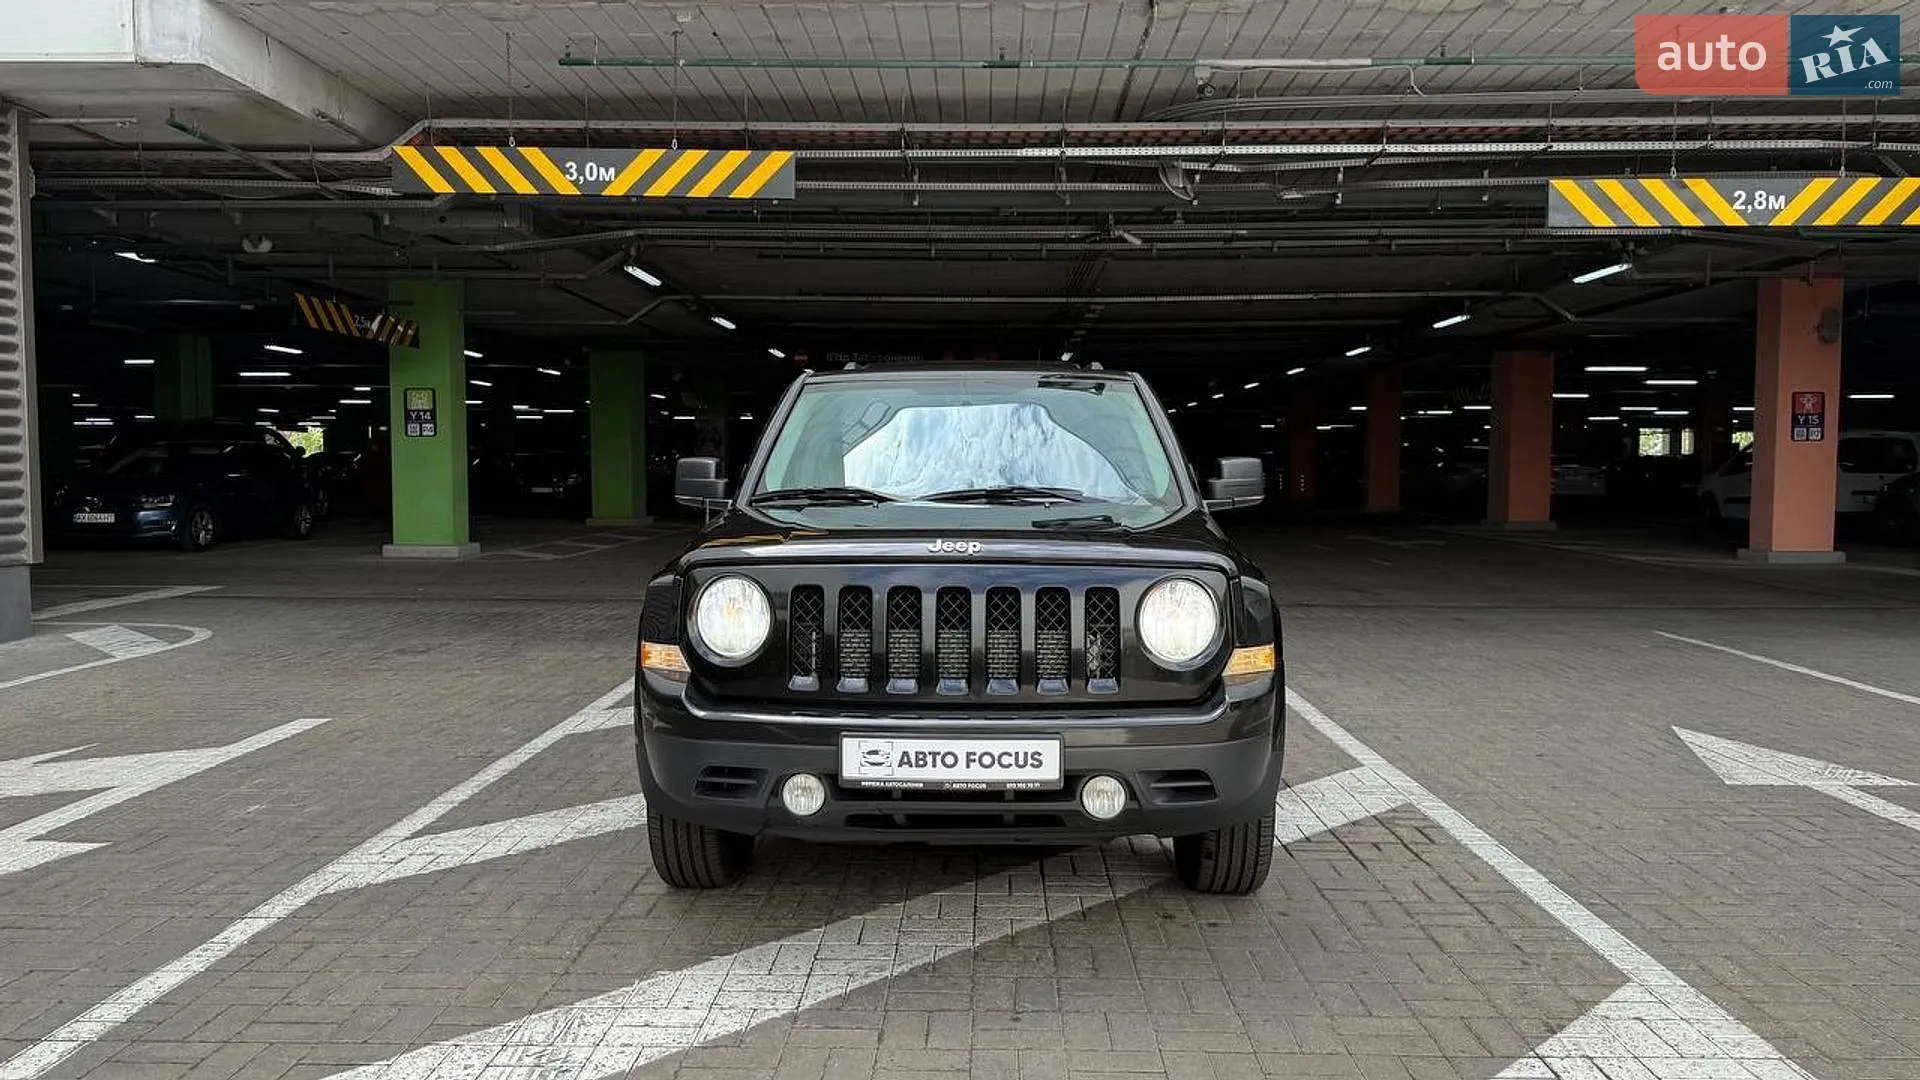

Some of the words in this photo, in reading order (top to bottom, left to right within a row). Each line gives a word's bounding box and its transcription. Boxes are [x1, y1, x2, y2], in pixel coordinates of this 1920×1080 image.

[565, 161, 615, 184] 3,0м
[1732, 190, 1786, 213] 2,8м
[420, 411, 431, 420] 14
[928, 539, 981, 555] Jeep
[897, 750, 959, 769] АВТО
[965, 750, 1044, 769] FOCUS
